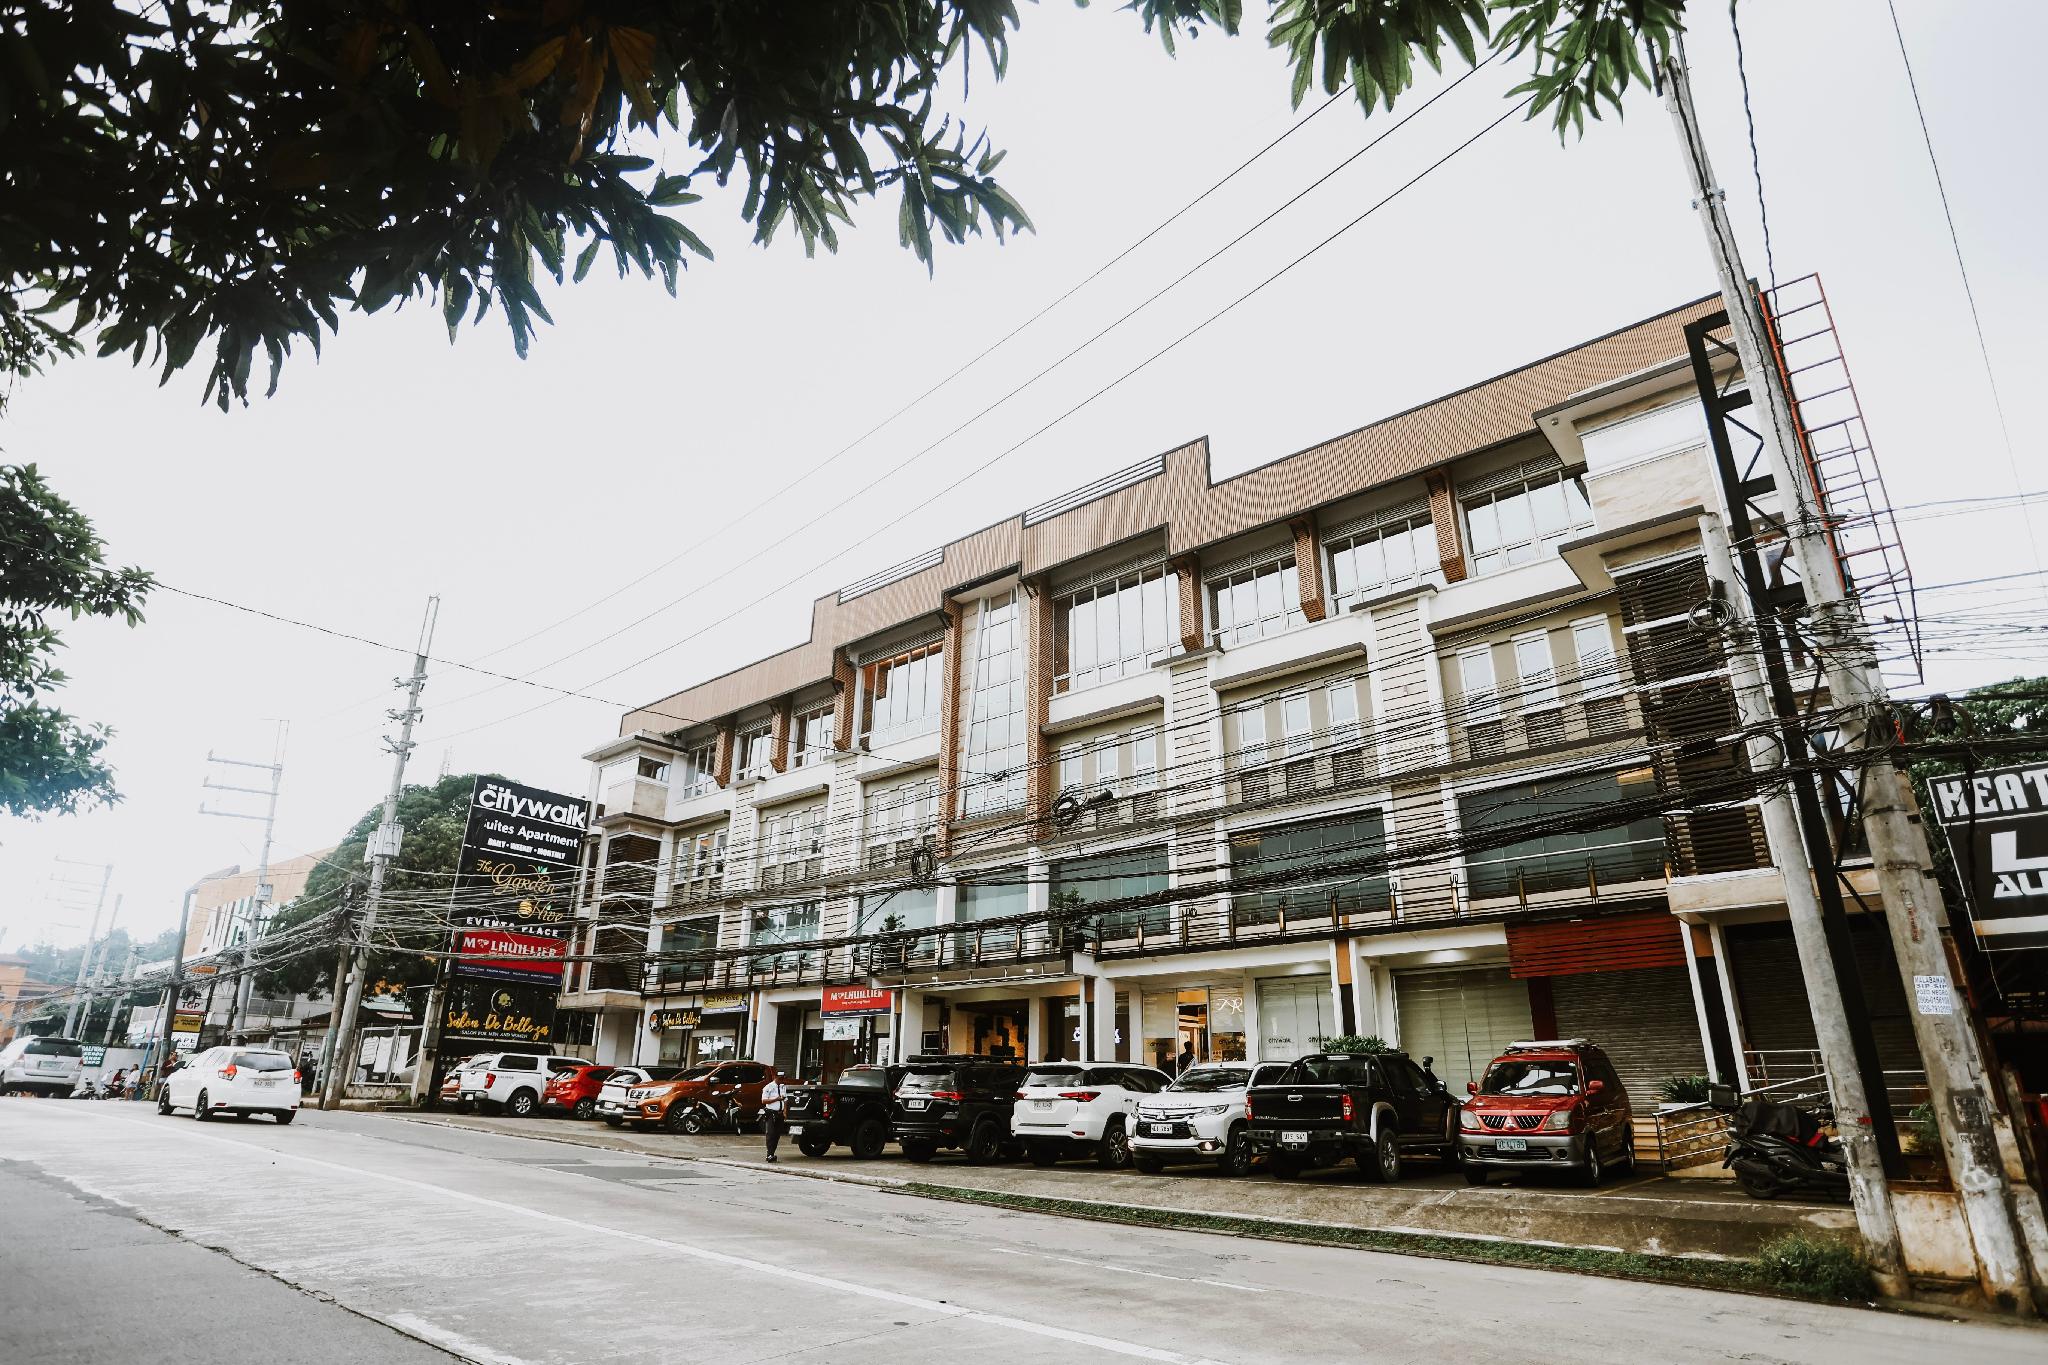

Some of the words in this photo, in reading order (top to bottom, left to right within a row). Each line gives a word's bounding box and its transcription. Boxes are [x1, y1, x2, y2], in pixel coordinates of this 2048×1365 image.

[484, 818, 515, 835] uites
[517, 826, 578, 848] Apartment
[476, 859, 492, 873] The
[491, 863, 556, 895] Garden
[466, 916, 515, 931] EVENTS
[521, 926, 559, 937] PLACE
[447, 1011, 480, 1029] Salon
[483, 1013, 501, 1030] De
[503, 1015, 549, 1040] Belleza
[1307, 1035, 1331, 1044] cityalk
